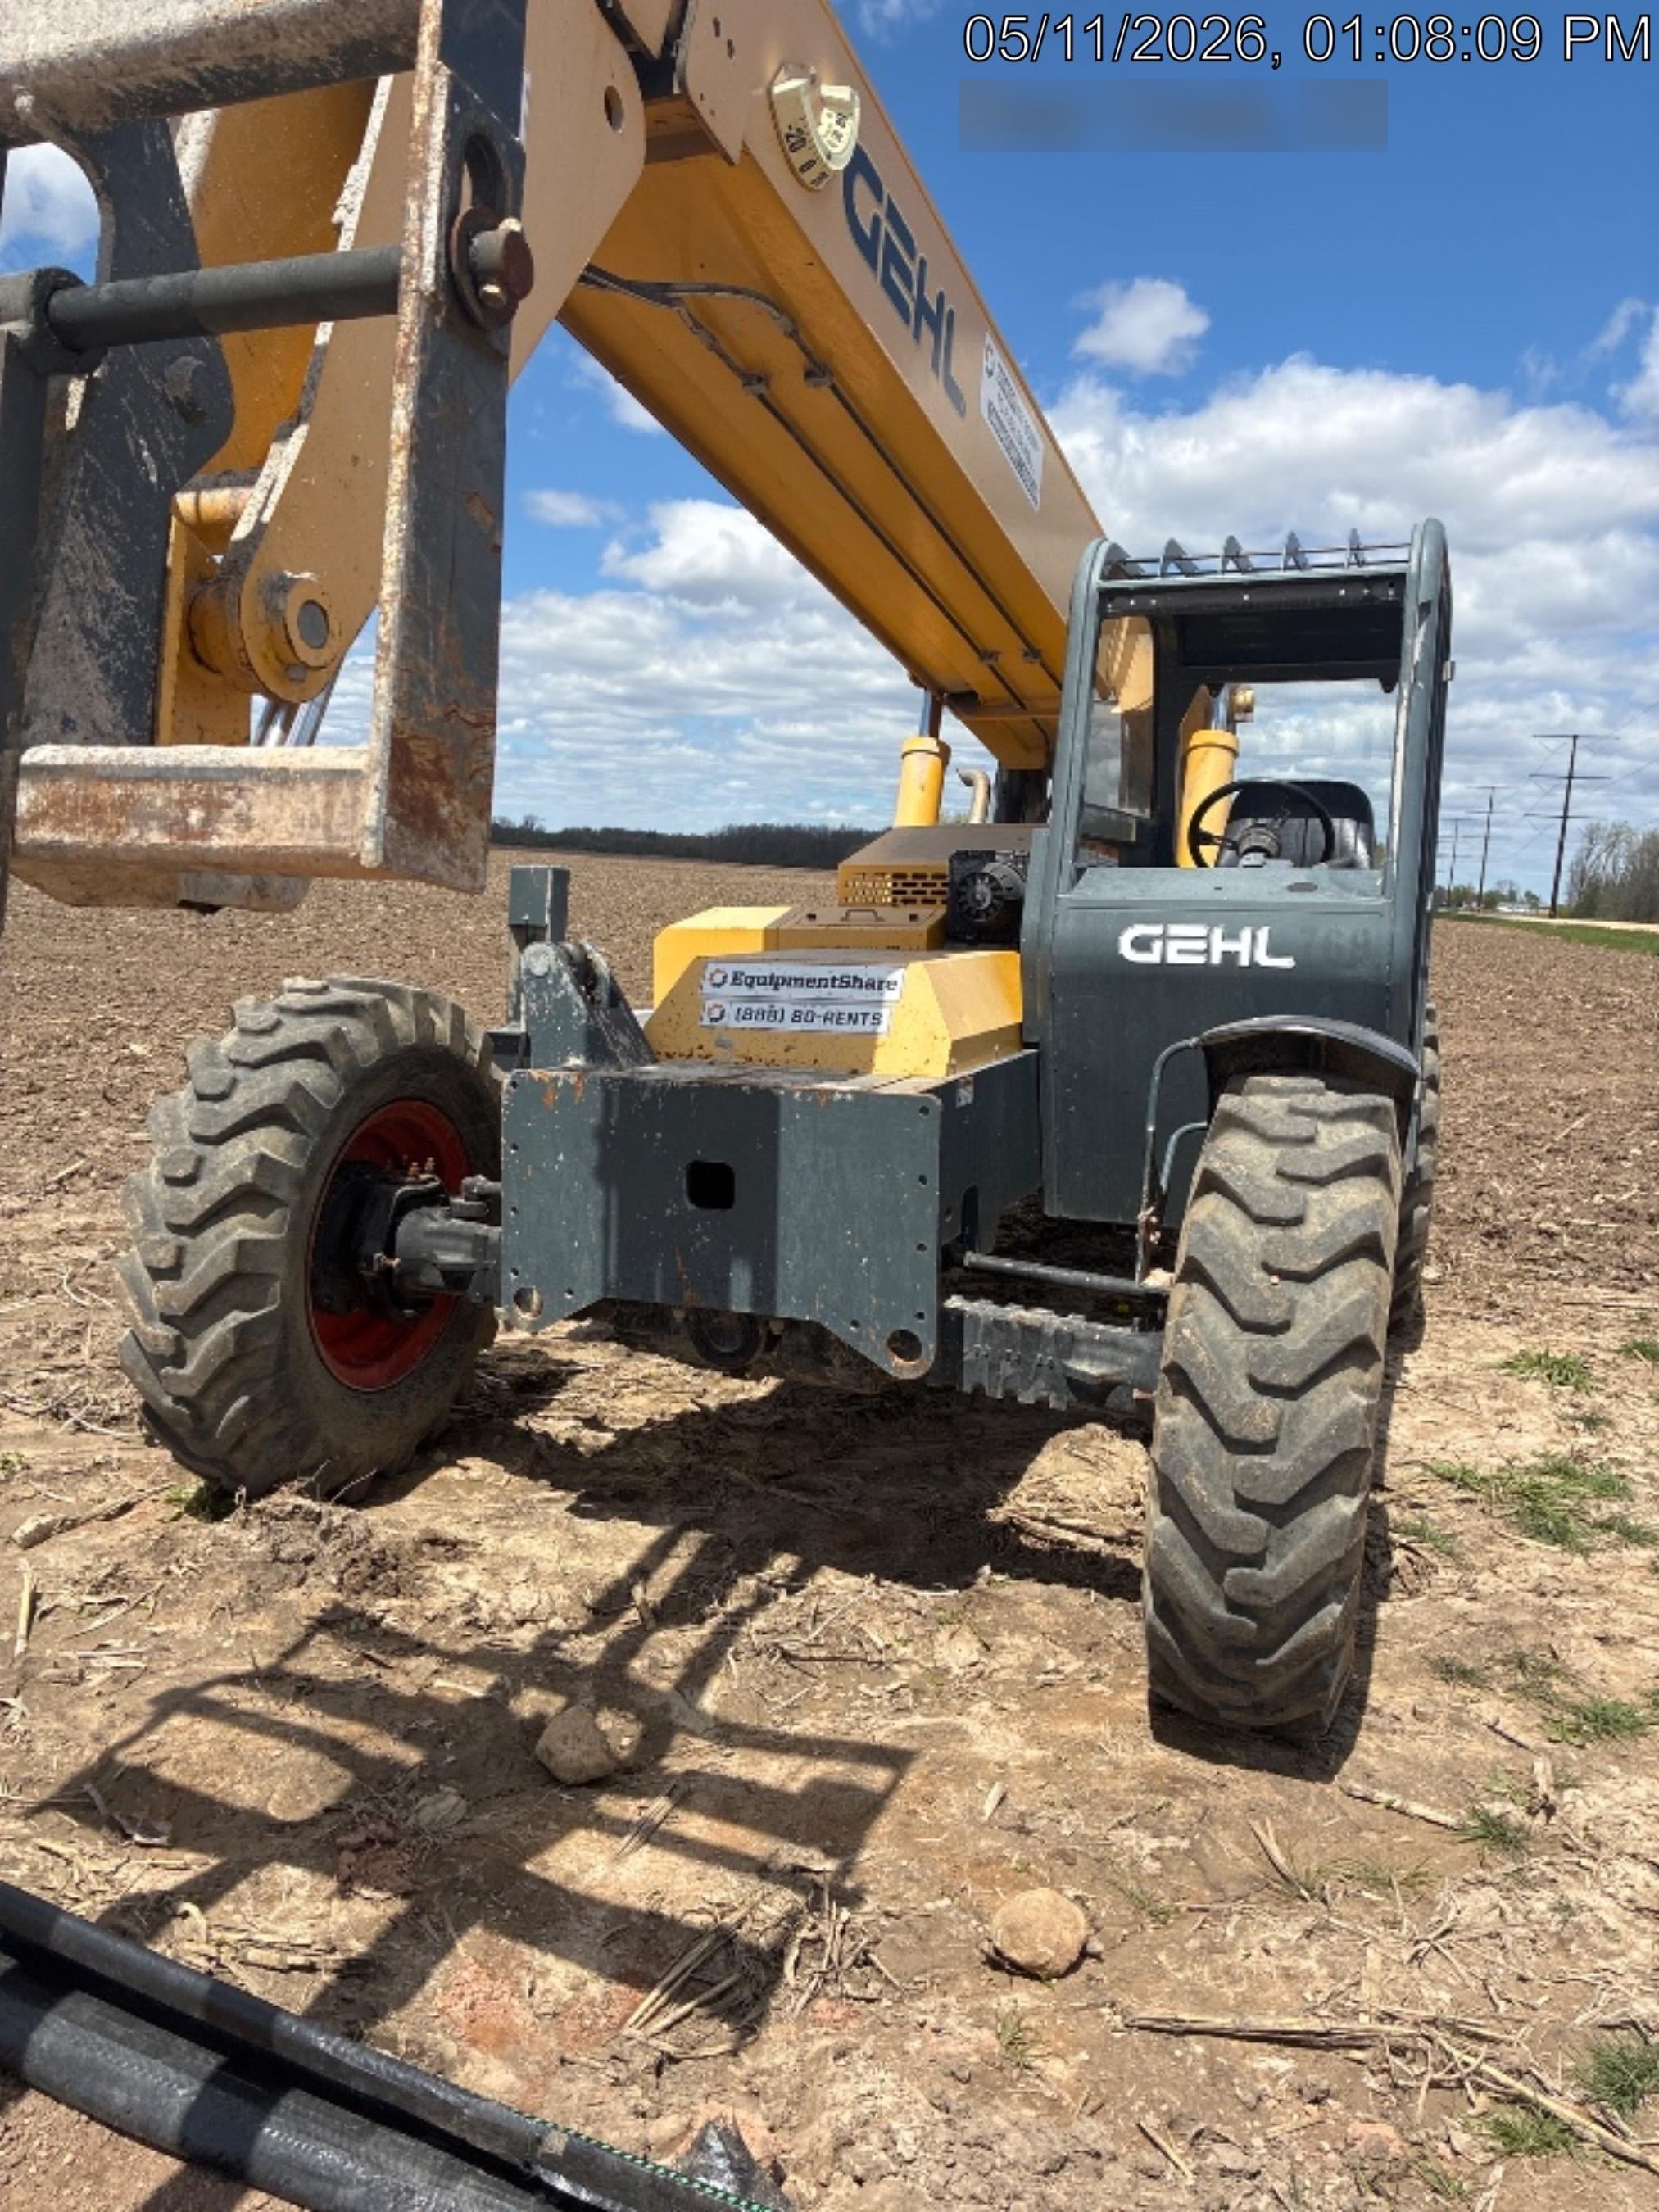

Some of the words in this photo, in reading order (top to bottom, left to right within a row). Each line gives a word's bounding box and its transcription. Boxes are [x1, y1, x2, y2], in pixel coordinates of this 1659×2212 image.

[842, 143, 966, 419] GEHL
[1118, 923, 1296, 969] GEHL
[730, 970, 898, 991] EquipmentShare
